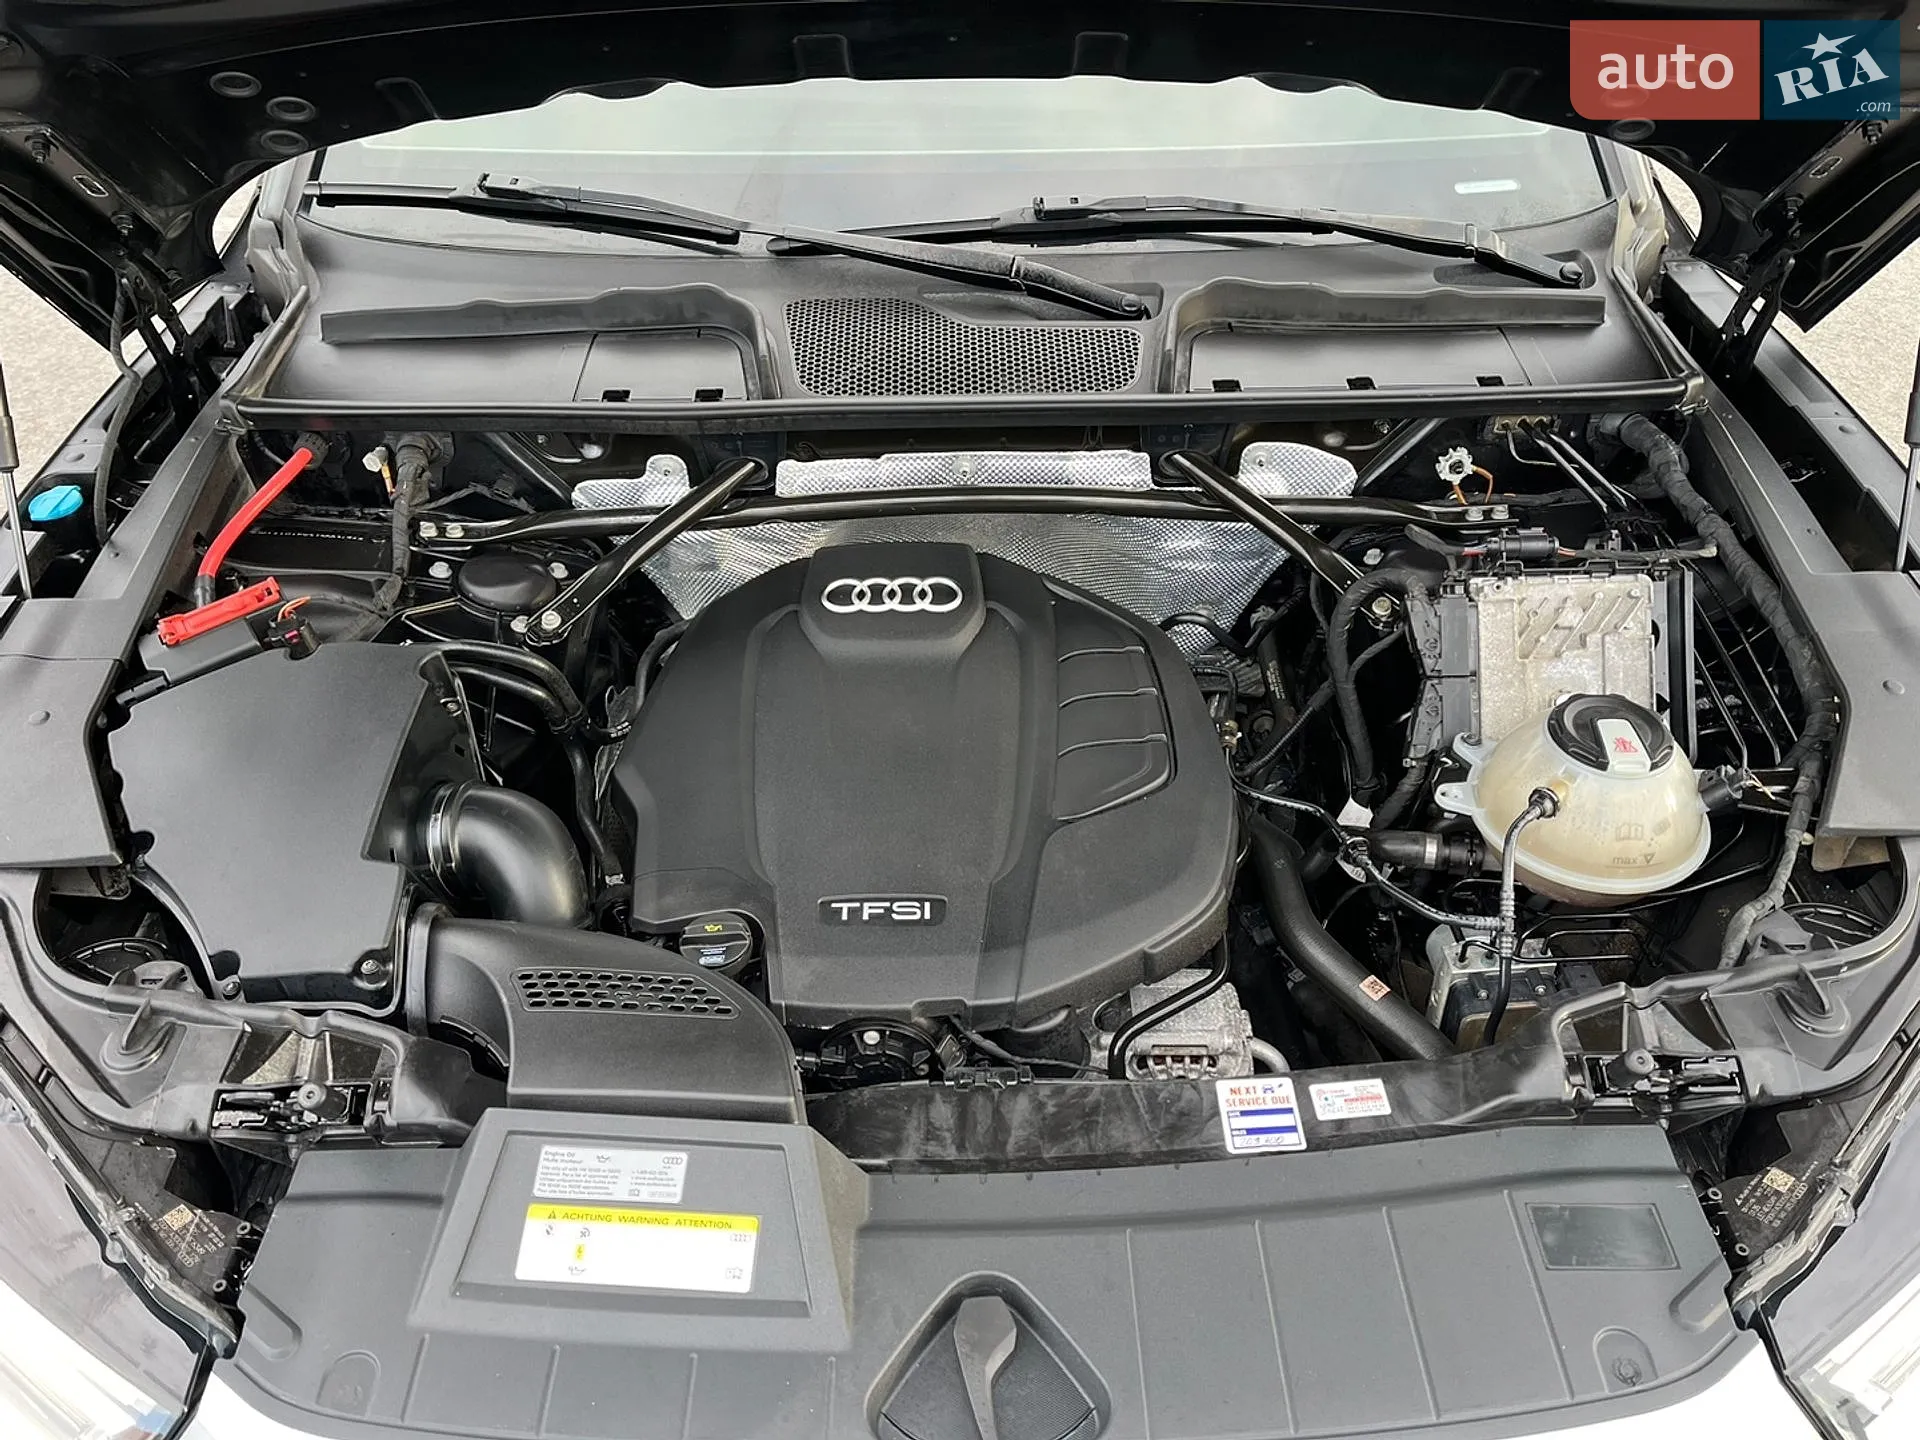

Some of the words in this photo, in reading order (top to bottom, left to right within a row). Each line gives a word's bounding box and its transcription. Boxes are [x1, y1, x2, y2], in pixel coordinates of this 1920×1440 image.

[1612, 856, 1638, 865] max
[830, 901, 931, 921] TFSI
[1229, 1085, 1257, 1096] NEXT
[1225, 1096, 1268, 1108] SERVICE
[1271, 1095, 1292, 1105] DUE
[544, 1150, 565, 1159] Engine
[562, 1212, 613, 1223] ACHTUNG
[618, 1215, 670, 1226] WARNING
[675, 1218, 732, 1230] ATTENTION
